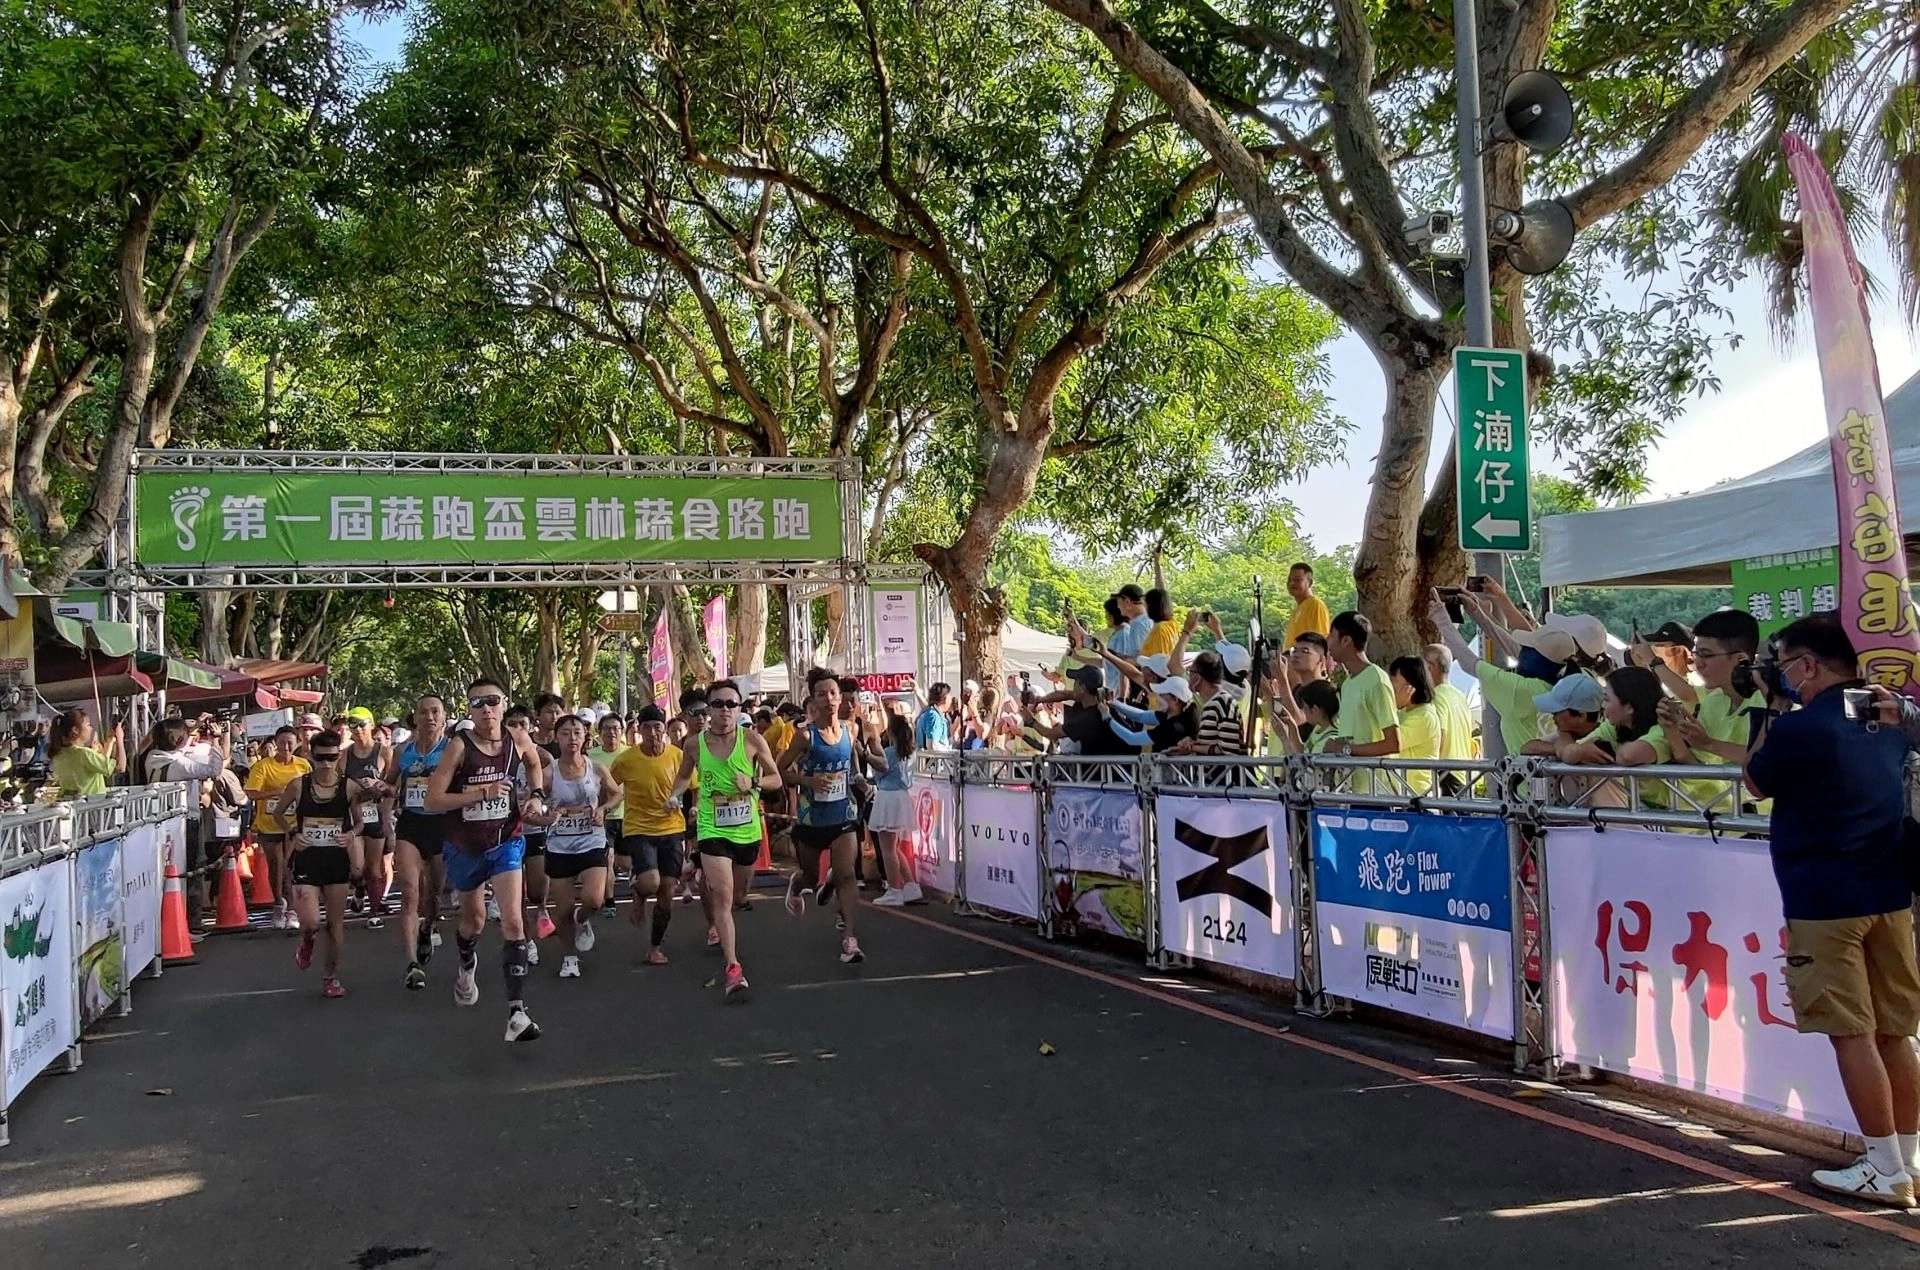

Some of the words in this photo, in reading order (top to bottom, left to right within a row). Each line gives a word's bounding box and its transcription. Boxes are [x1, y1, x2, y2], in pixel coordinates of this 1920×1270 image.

[1471, 359, 1515, 505] 下湳仔
[220, 494, 811, 541] 第一屆蔬跑盃雲林蔬食路跑
[1747, 584, 1837, 621] 裁判組
[971, 824, 1030, 846] VOLVO
[1417, 851, 1439, 872] Flex
[1418, 871, 1452, 892] Power
[1203, 915, 1247, 947] 2124
[1366, 955, 1418, 996] 原戰力
